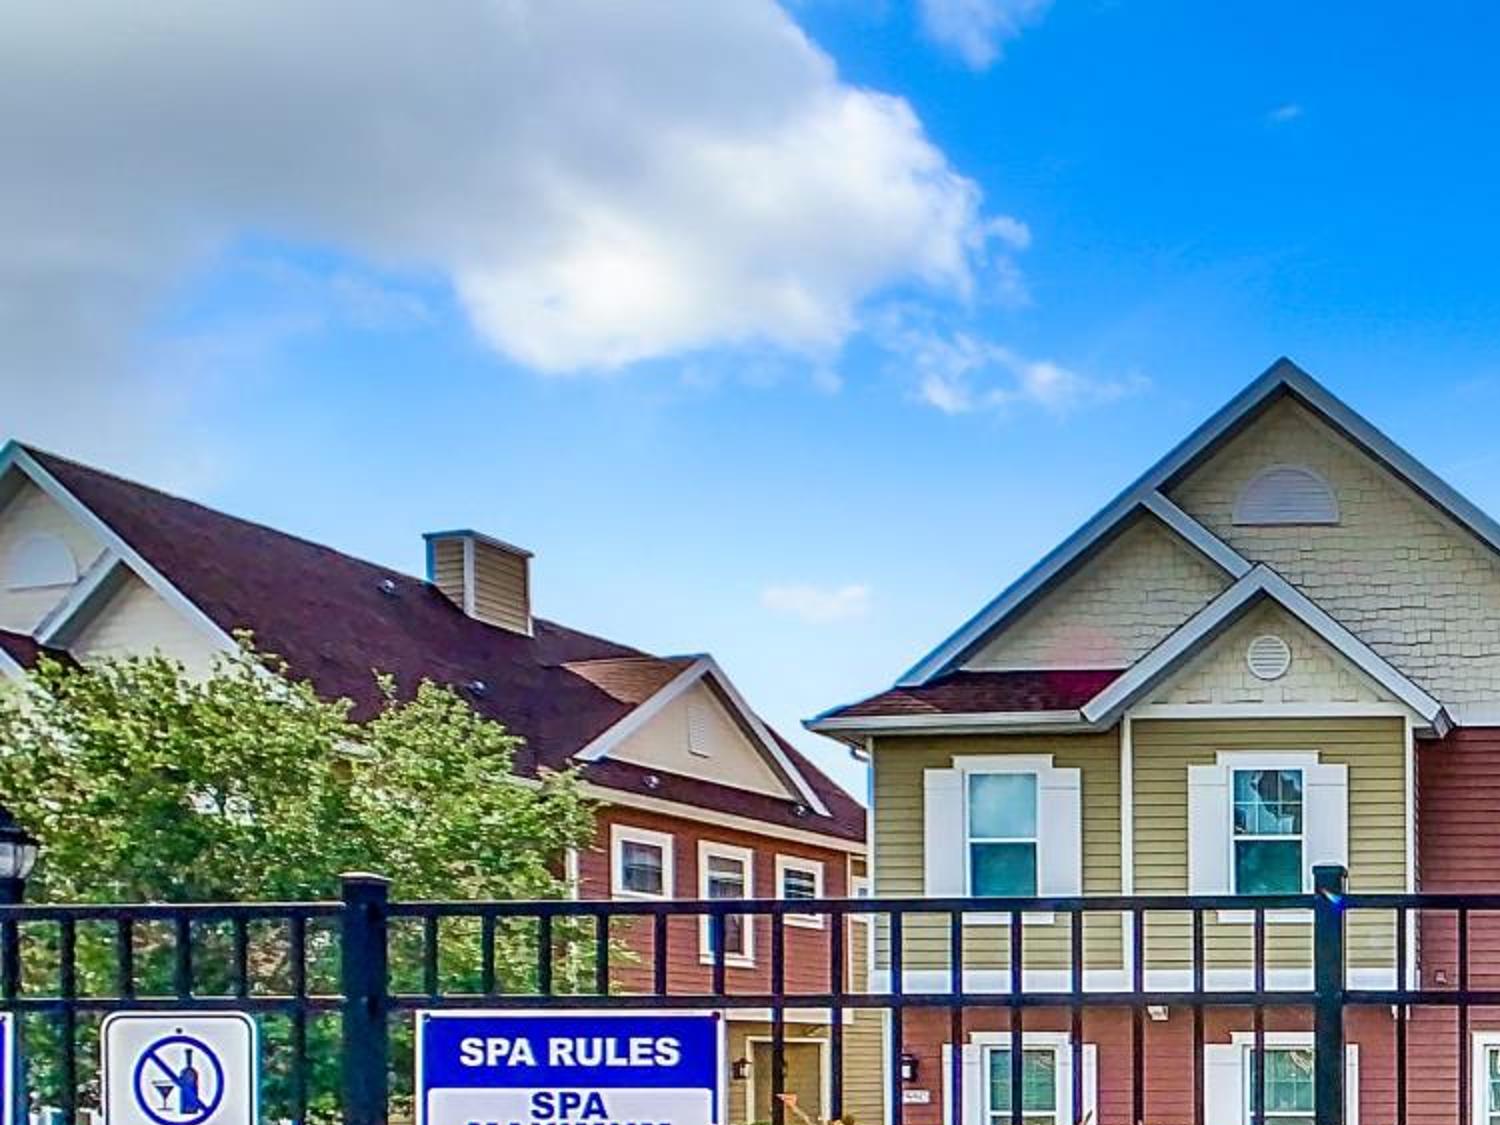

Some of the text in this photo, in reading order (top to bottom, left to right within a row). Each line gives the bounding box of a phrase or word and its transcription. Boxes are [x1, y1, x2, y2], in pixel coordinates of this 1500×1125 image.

[460, 1037, 682, 1067] SPA RULES
[531, 1092, 609, 1120] SPA
